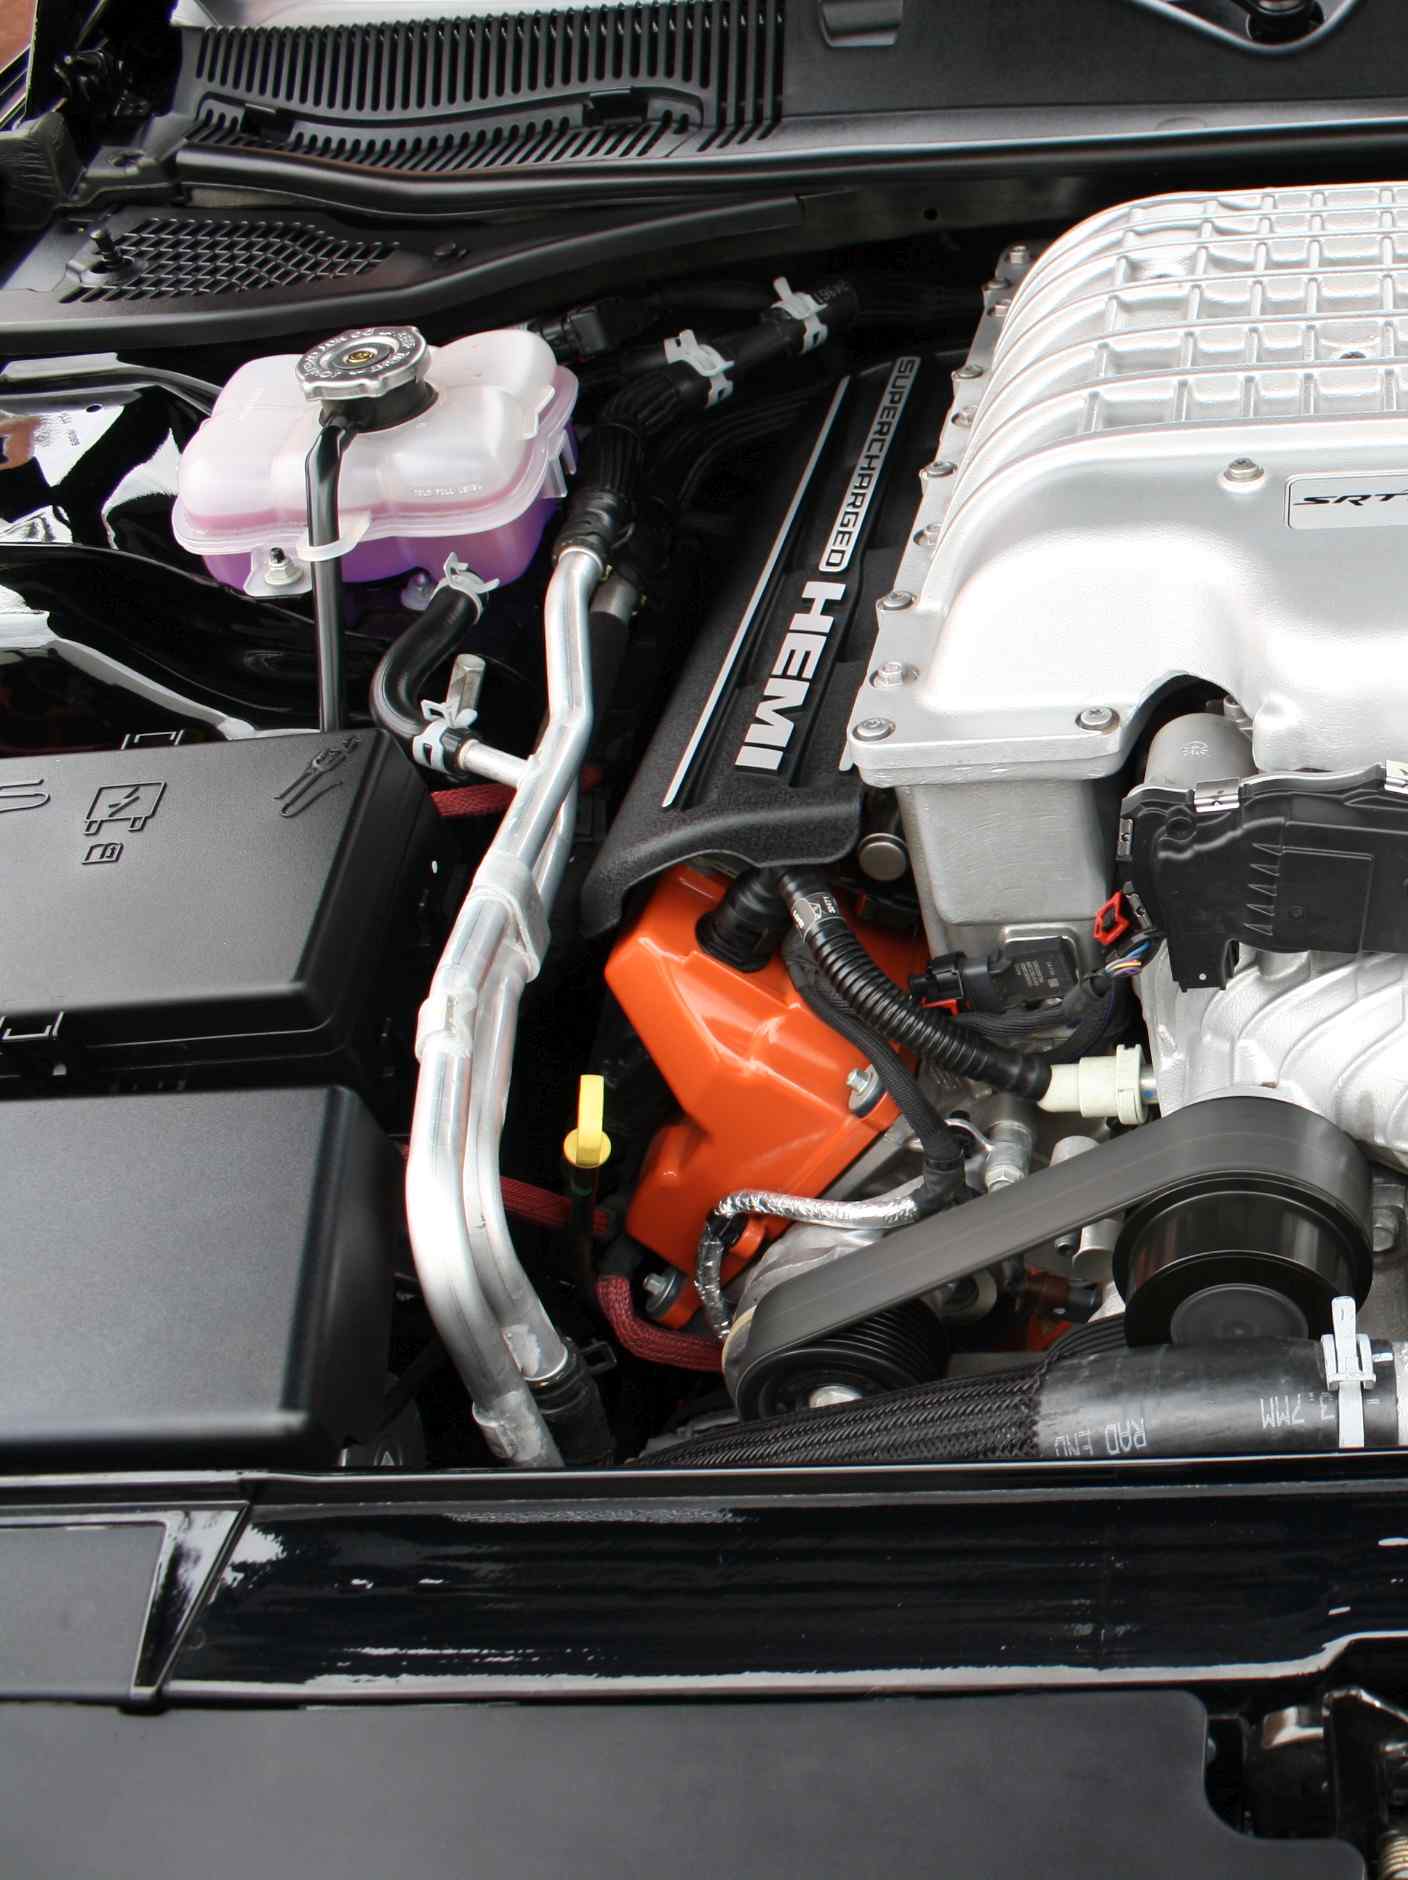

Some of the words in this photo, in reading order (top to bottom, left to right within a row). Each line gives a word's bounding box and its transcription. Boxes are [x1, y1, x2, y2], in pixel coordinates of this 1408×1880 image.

[824, 357, 917, 569] SUPERCHARGED
[1293, 492, 1408, 506] SRT
[734, 581, 847, 771] HEMI
[1104, 1416, 1148, 1456] RAD
